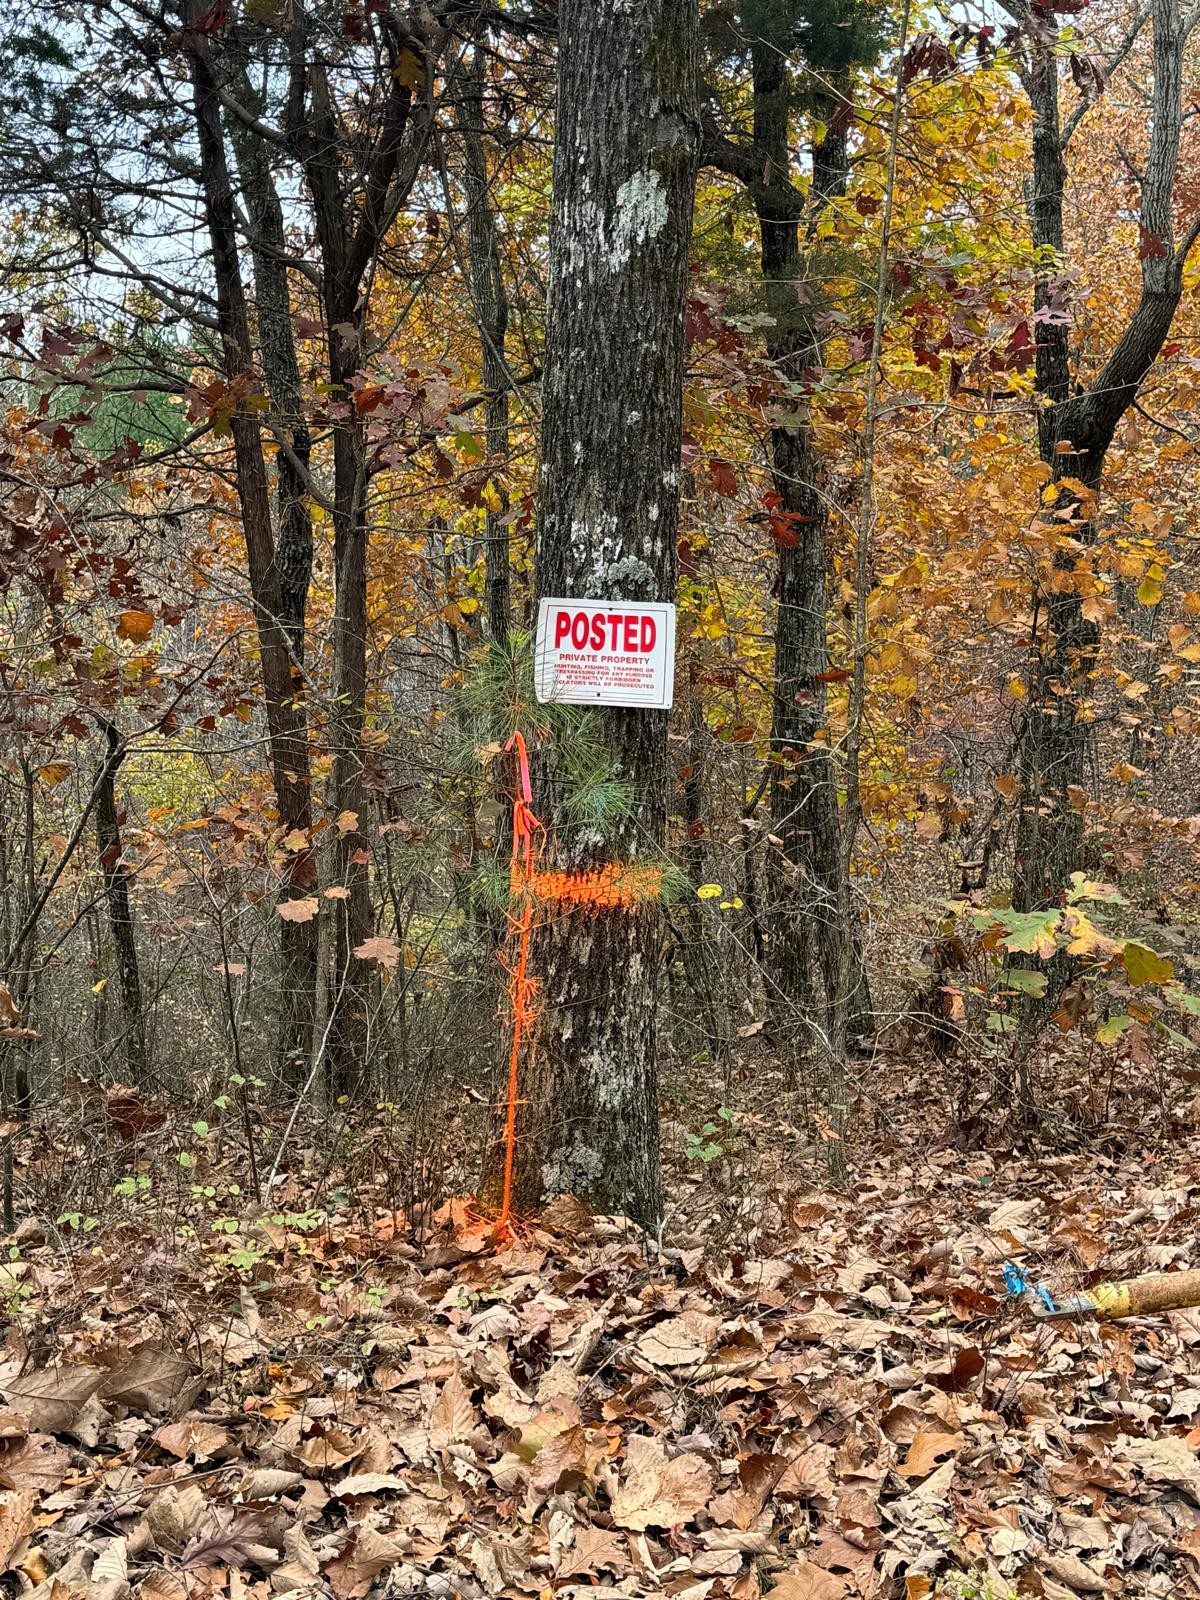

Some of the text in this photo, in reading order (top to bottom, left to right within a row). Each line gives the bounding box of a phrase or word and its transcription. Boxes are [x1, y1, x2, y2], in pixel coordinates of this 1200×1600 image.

[554, 611, 656, 652] POSTED
[559, 653, 650, 664] PRIVATE PROPERTY
